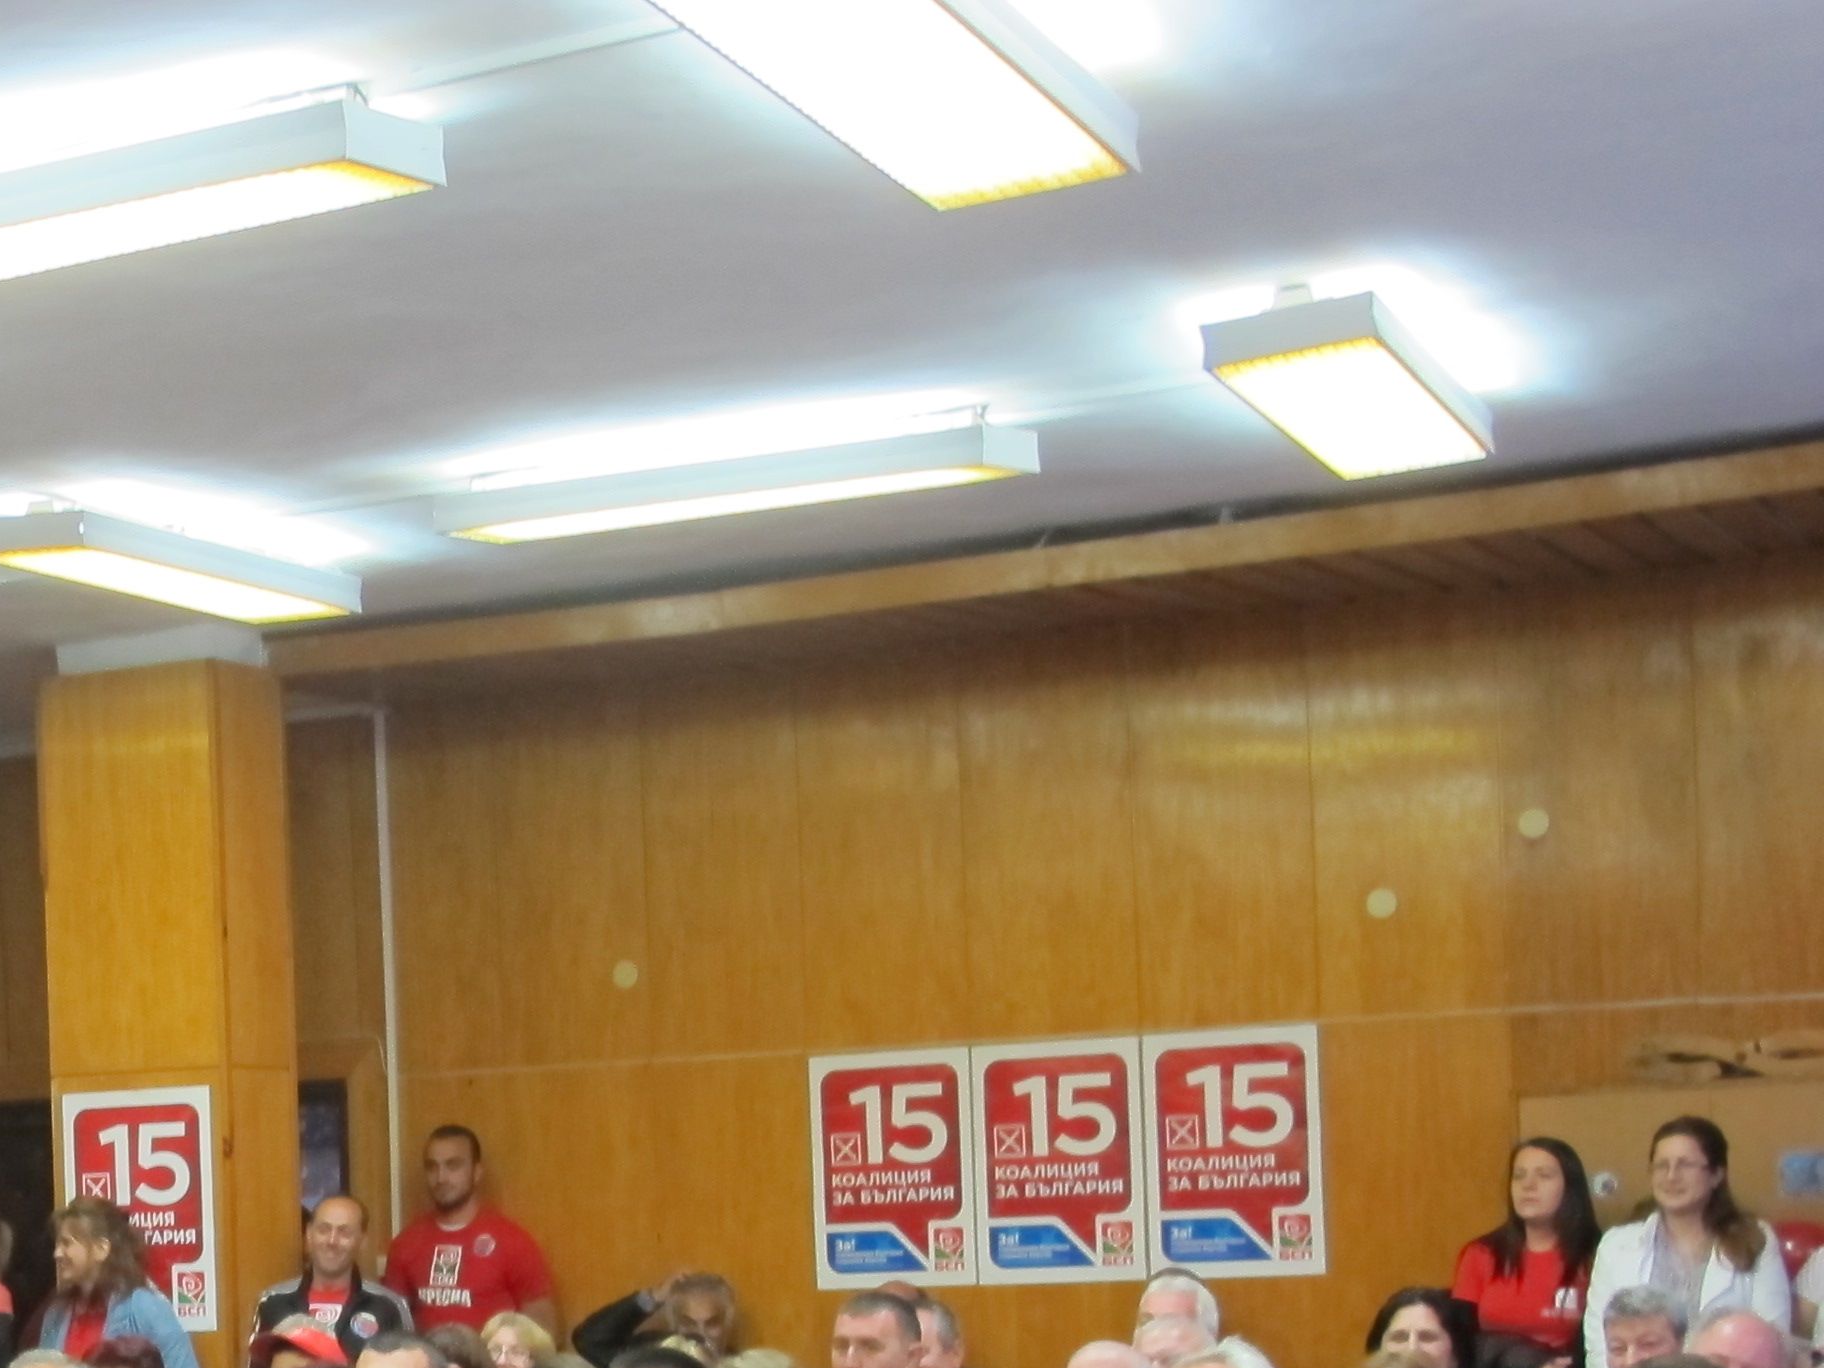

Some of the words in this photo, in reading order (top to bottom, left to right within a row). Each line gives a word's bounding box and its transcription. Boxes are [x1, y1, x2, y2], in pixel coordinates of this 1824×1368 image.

[1012, 1072, 1116, 1157] 15
[1186, 1061, 1294, 1148] 15
[848, 1081, 947, 1164] 15
[99, 1121, 191, 1207] 15
[994, 1161, 1099, 1180] КОАЛИЦИЯ
[1166, 1153, 1275, 1172] КОАЛИЦИЯ
[832, 1169, 932, 1187] КОАЛИЦИЯ
[1168, 1175, 1192, 1192] ЗА
[1198, 1170, 1301, 1190] БЪЛГАРИЯ
[833, 1190, 855, 1206] ЗА
[861, 1186, 955, 1204] БЪЛГАРИЯ
[995, 1183, 1018, 1199] ЗА
[1025, 1178, 1124, 1197] БЪЛГАРИЯ
[129, 1211, 175, 1229] ИЦИЯ
[144, 1228, 196, 1246] ГАРИЯ
